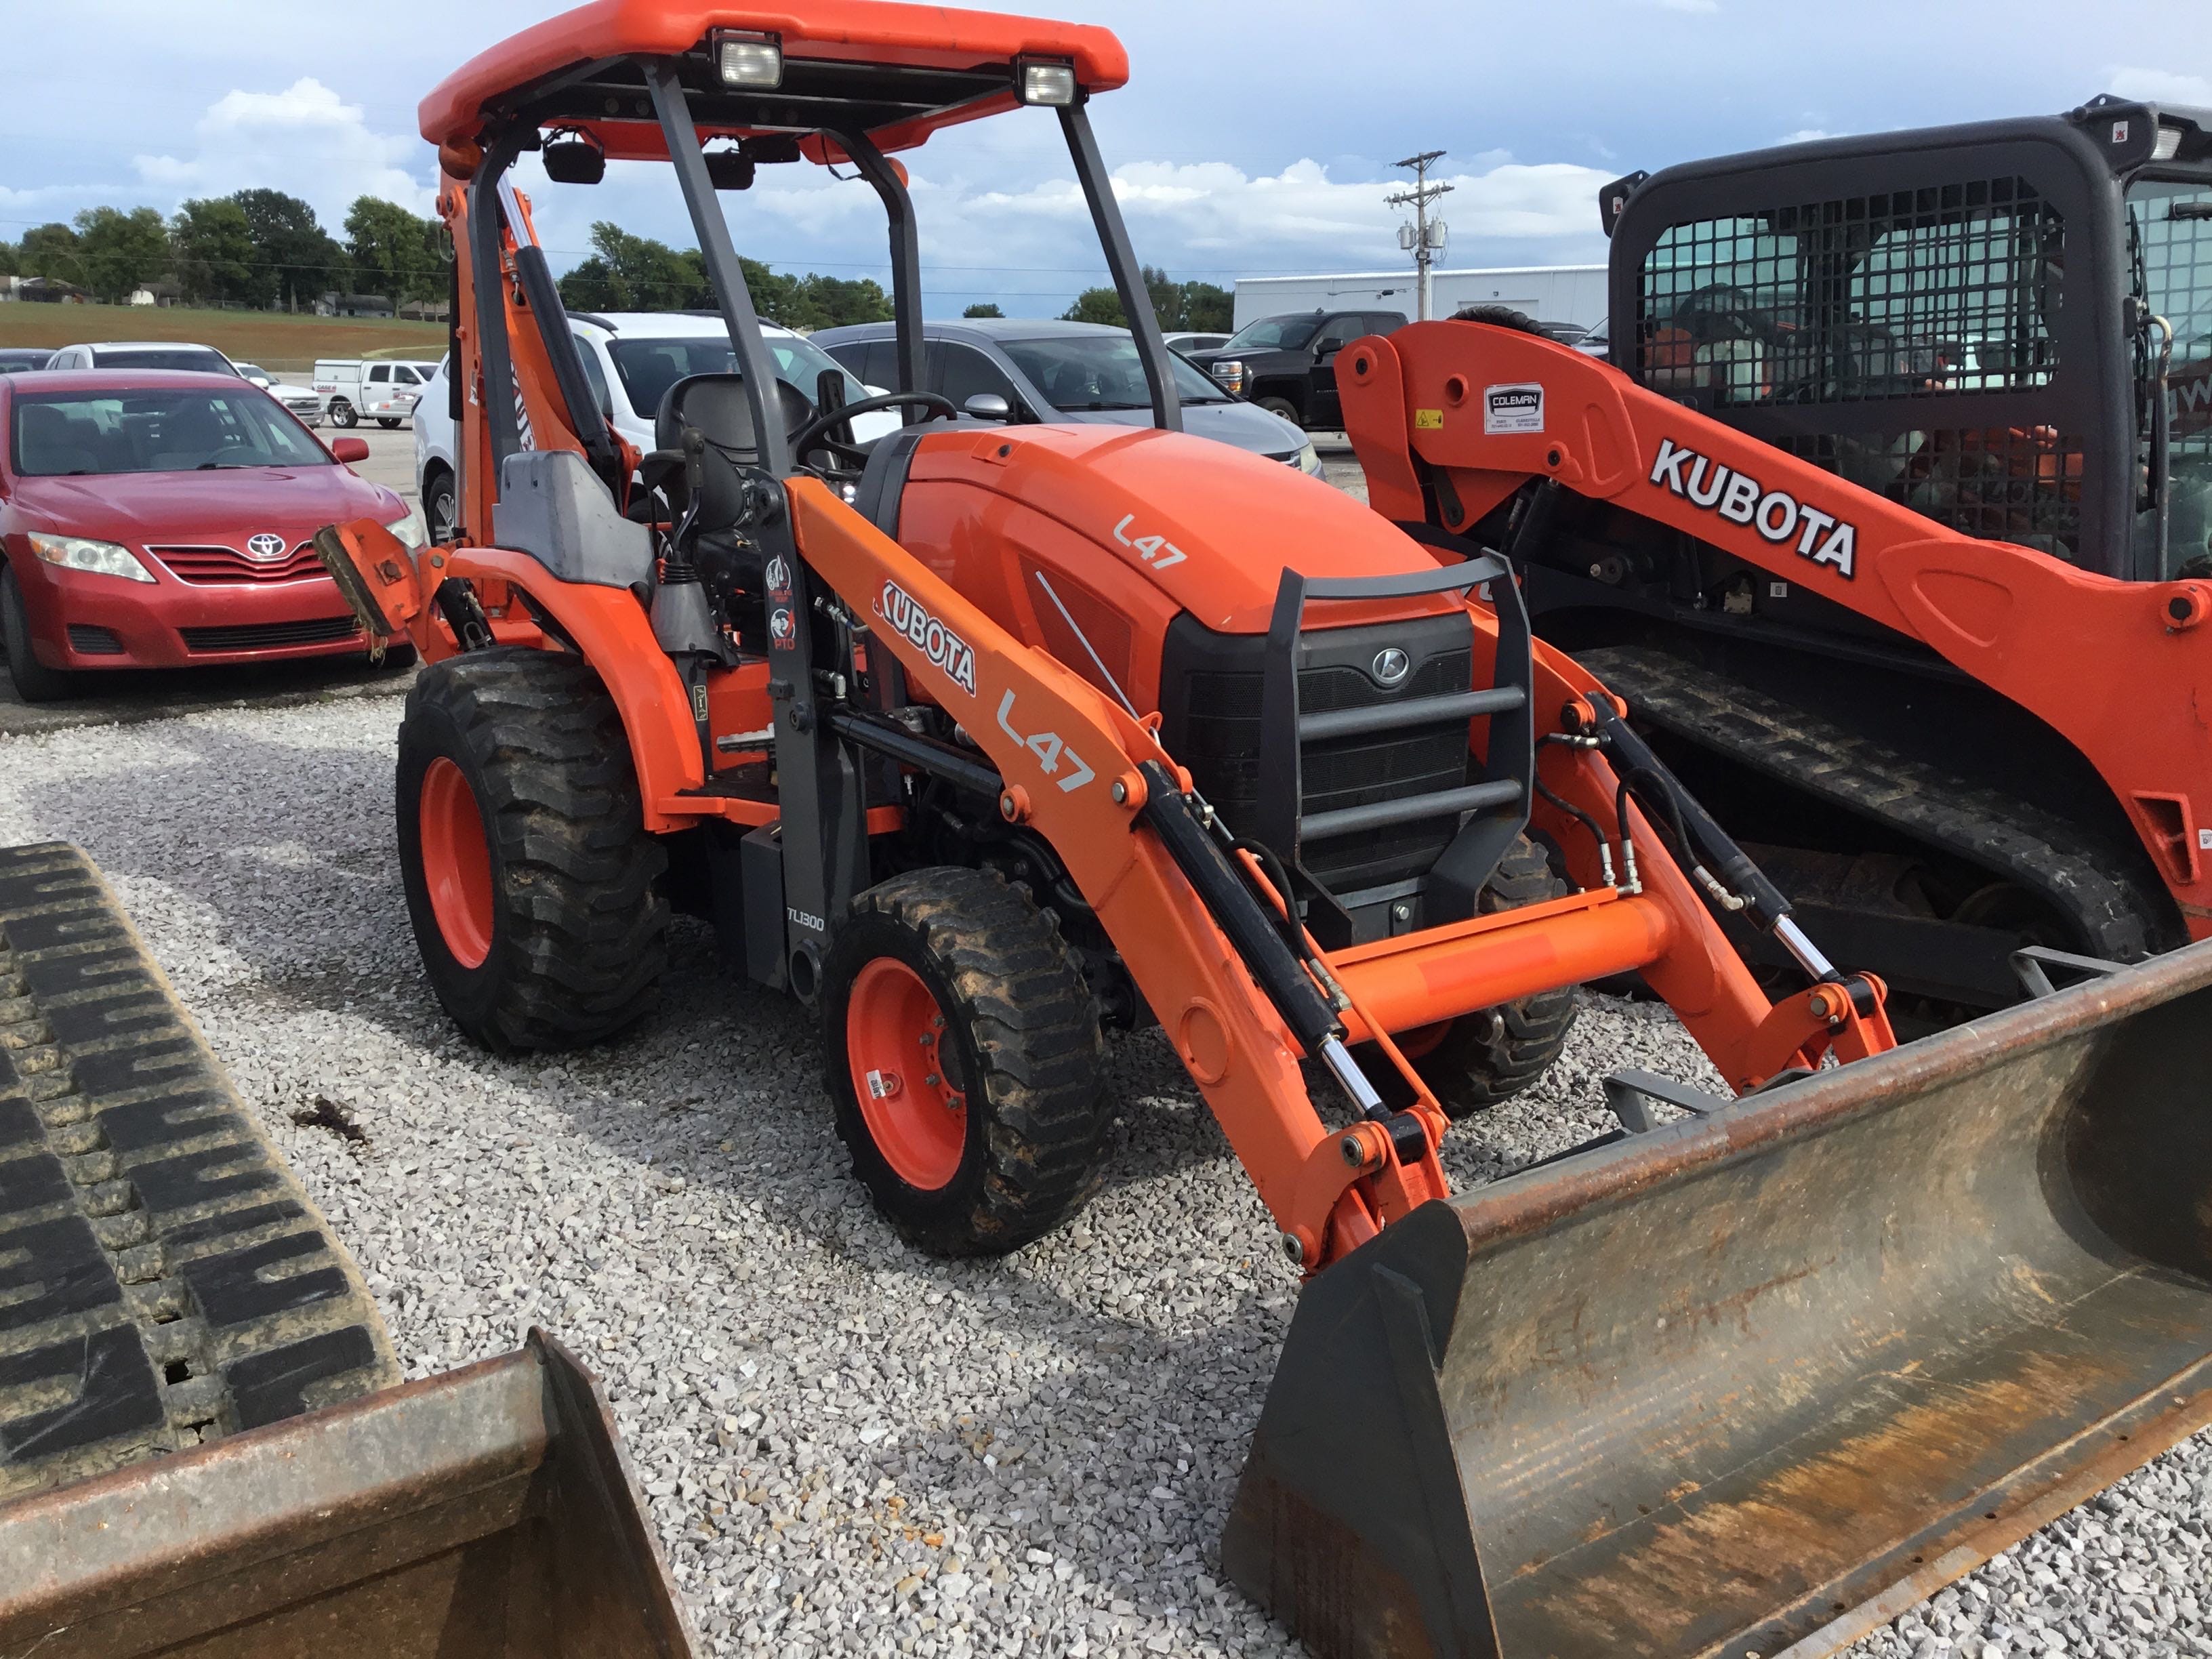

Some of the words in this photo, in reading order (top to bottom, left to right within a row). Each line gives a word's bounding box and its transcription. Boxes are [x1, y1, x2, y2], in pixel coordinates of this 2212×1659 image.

[1493, 394, 1537, 406] COLEMAN
[1650, 438, 1856, 577] KUBOTA
[1112, 513, 1188, 570] L47
[774, 637, 796, 651] PTO
[996, 687, 1096, 794] L47
[787, 907, 825, 932] TL1300
